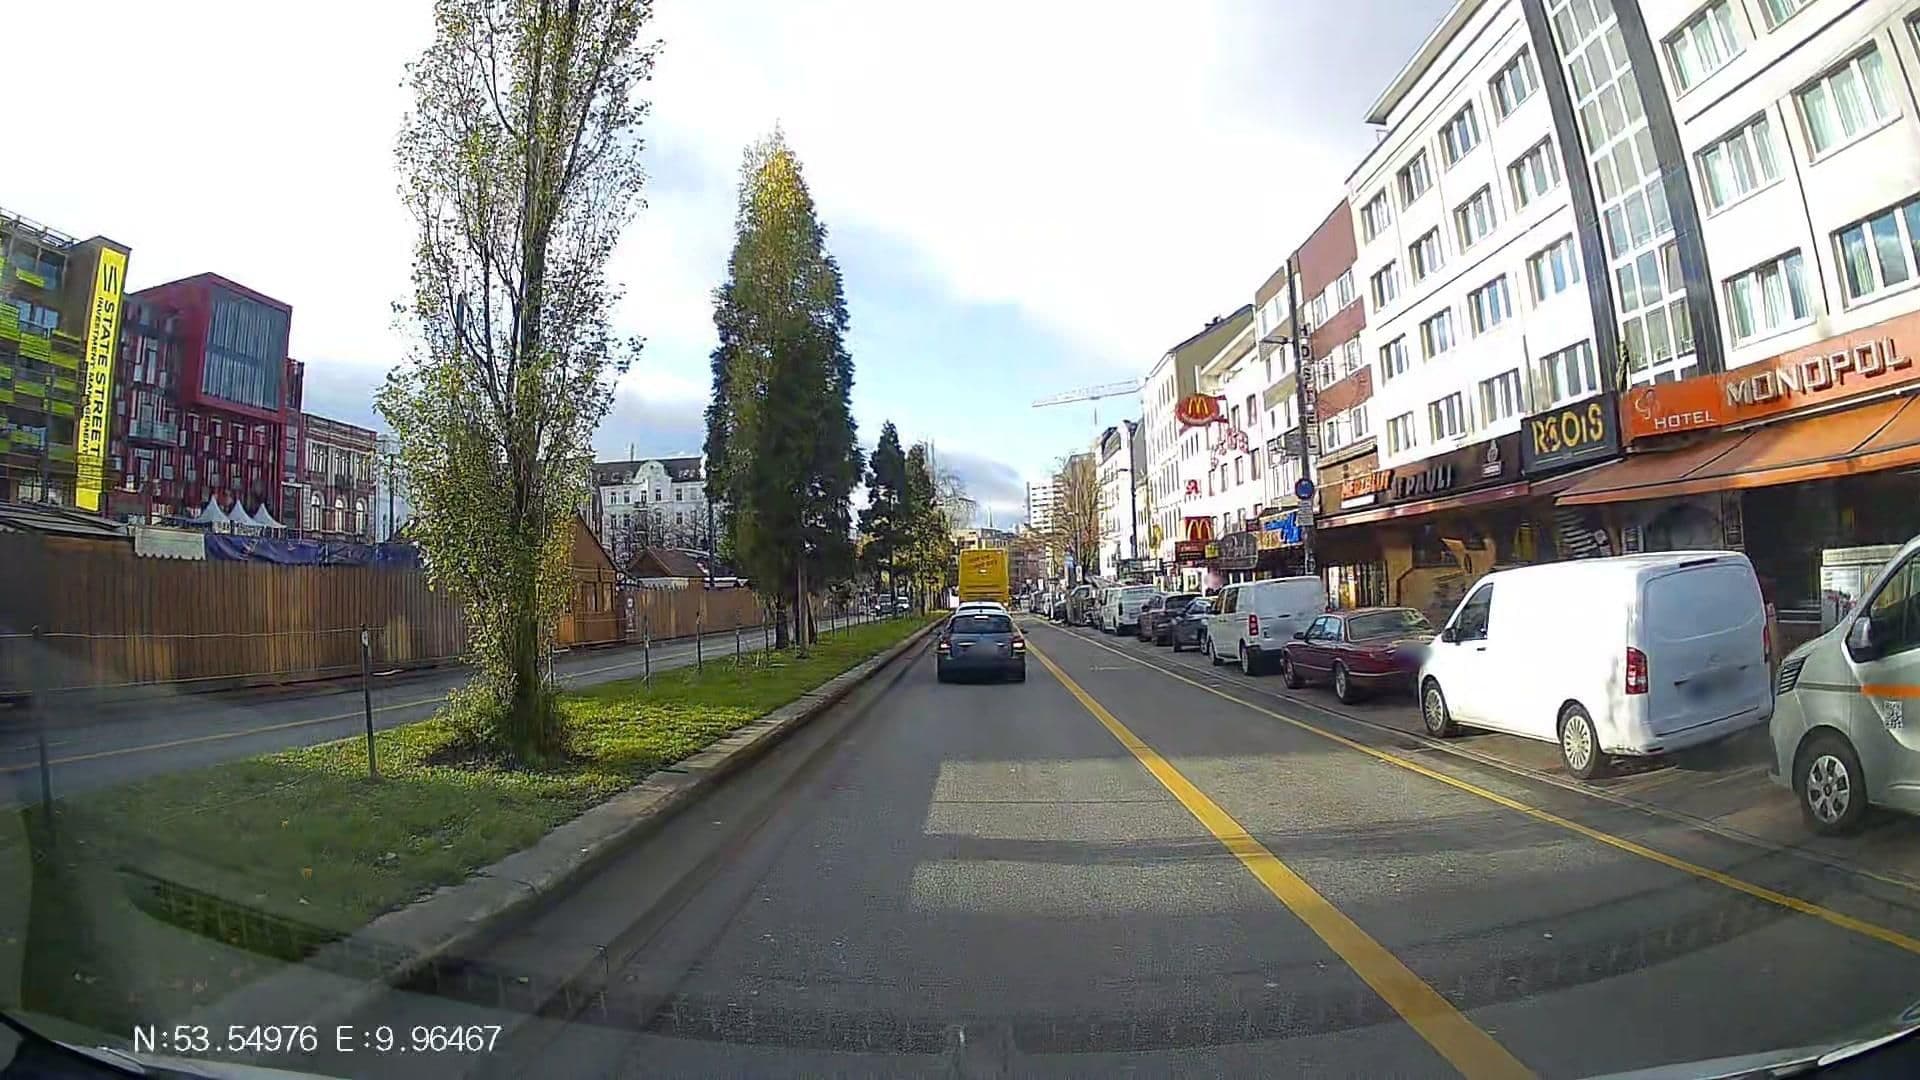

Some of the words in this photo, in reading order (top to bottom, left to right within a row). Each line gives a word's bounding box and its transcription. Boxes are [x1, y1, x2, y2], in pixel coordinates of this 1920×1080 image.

[97, 300, 115, 367] STATE
[90, 371, 106, 457] STREET
[1654, 411, 1716, 430] HOTEL
[1727, 335, 1913, 407] MONOPOL
